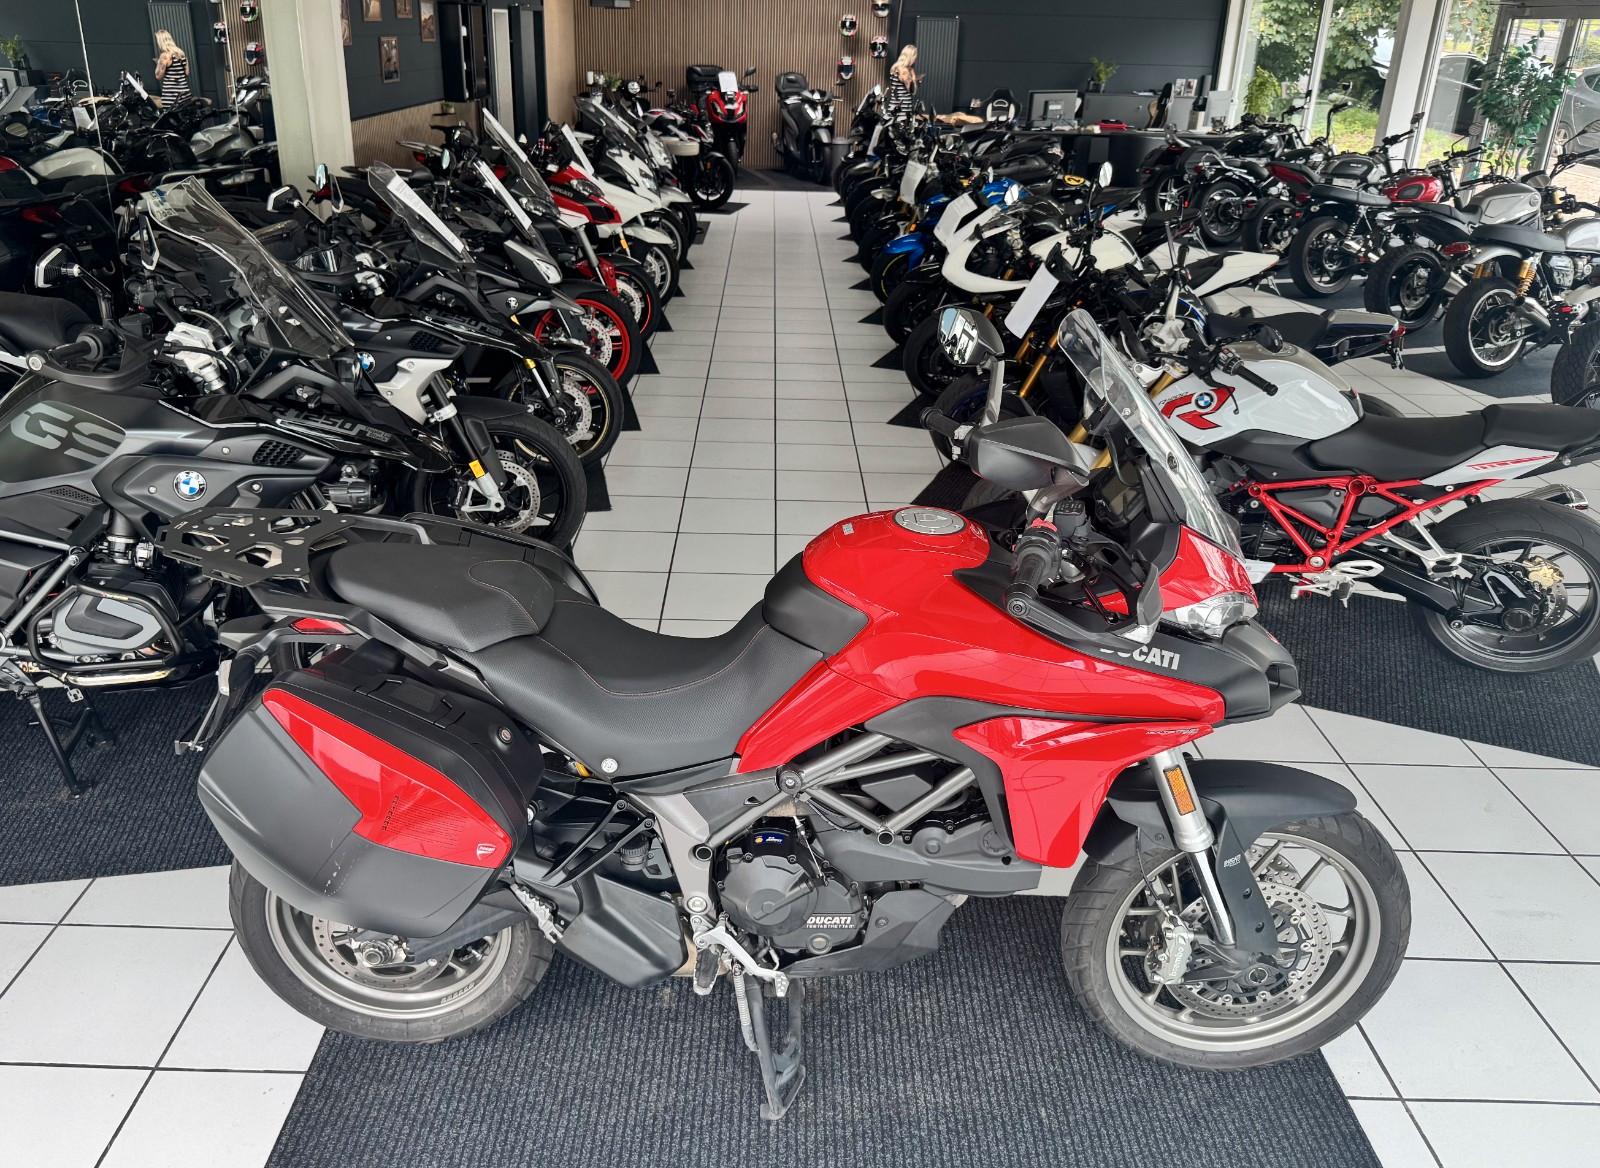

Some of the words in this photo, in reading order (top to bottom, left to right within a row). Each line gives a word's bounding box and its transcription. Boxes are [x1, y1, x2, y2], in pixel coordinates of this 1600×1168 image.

[10, 402, 127, 466] GS
[1099, 644, 1181, 671] CATI
[806, 916, 852, 925] DUCATI
[1170, 946, 1185, 977] brembo
